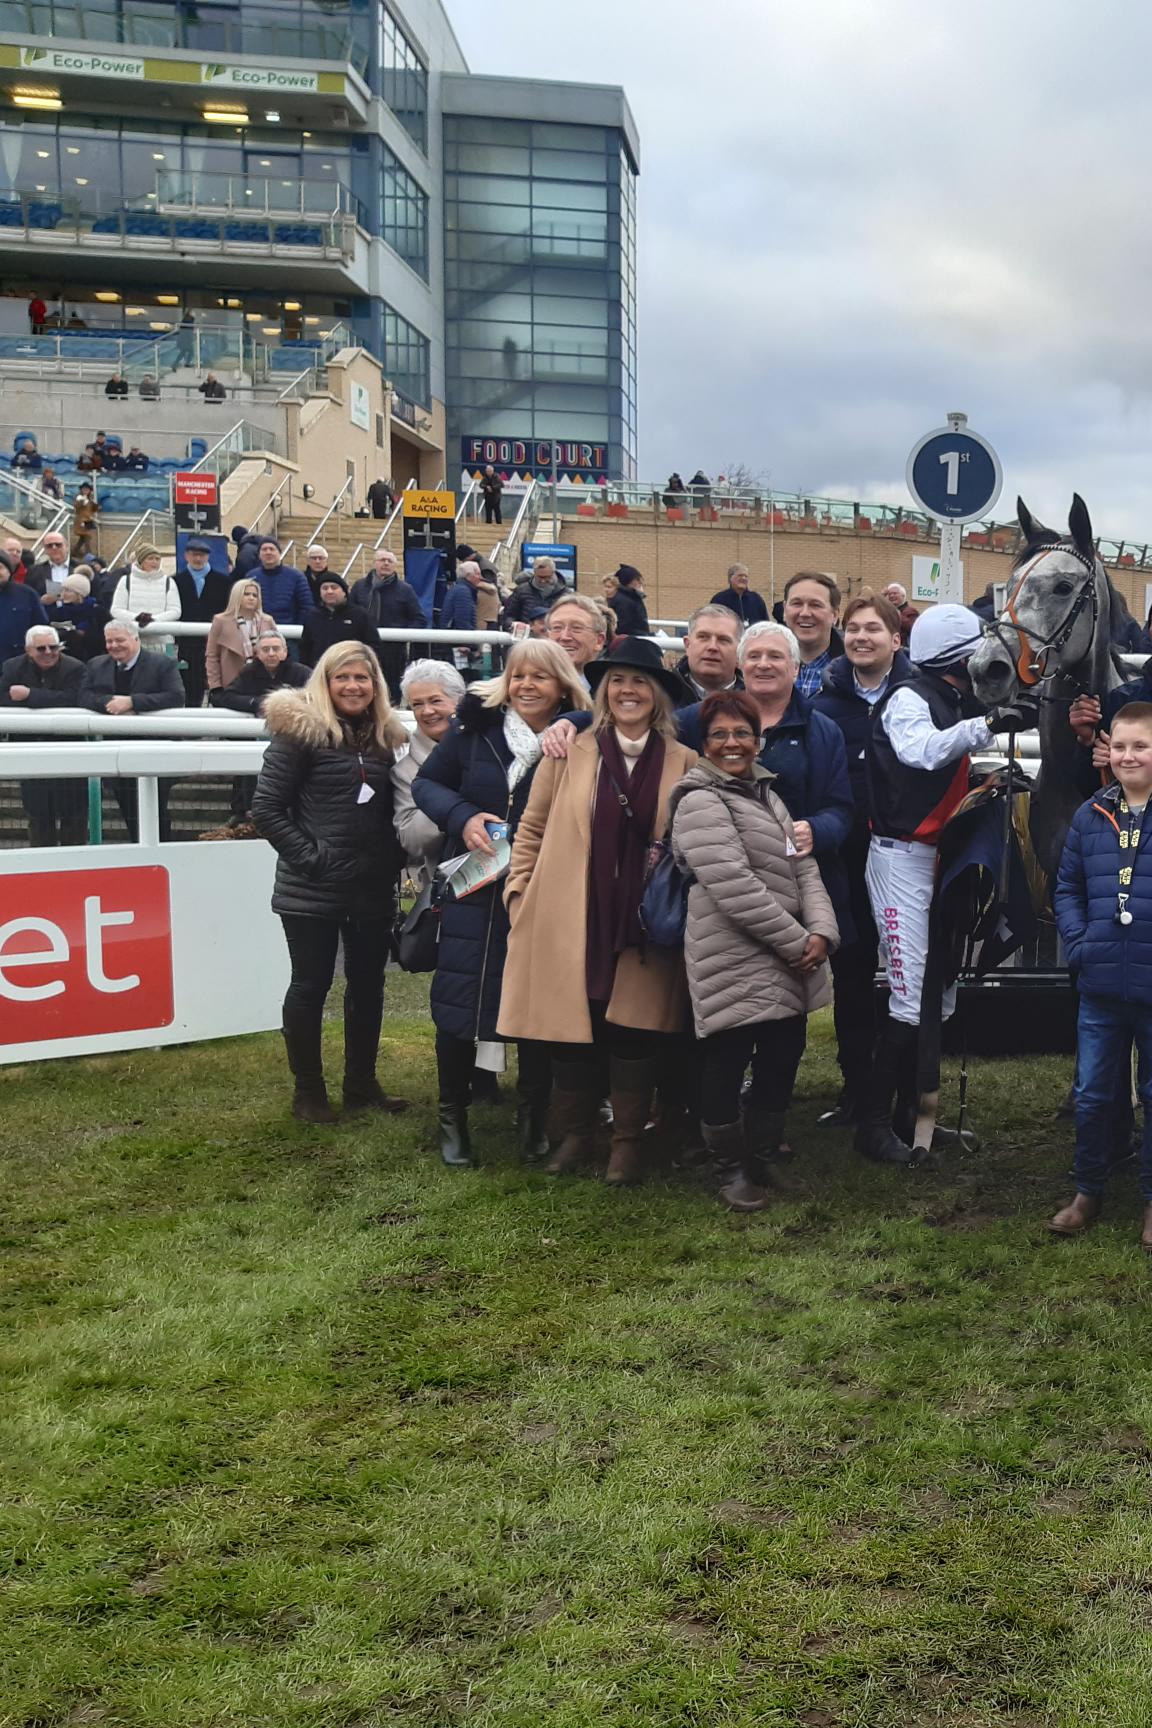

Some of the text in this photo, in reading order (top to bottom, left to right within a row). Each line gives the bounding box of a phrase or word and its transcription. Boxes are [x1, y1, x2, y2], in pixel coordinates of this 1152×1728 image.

[53, 54, 143, 74] Eco-Power
[232, 69, 316, 88] Eco-Power
[471, 439, 605, 468] FOOD COURT
[411, 504, 448, 513] RACING
[0, 895, 141, 1002] et
[884, 907, 907, 996] BRESBET
